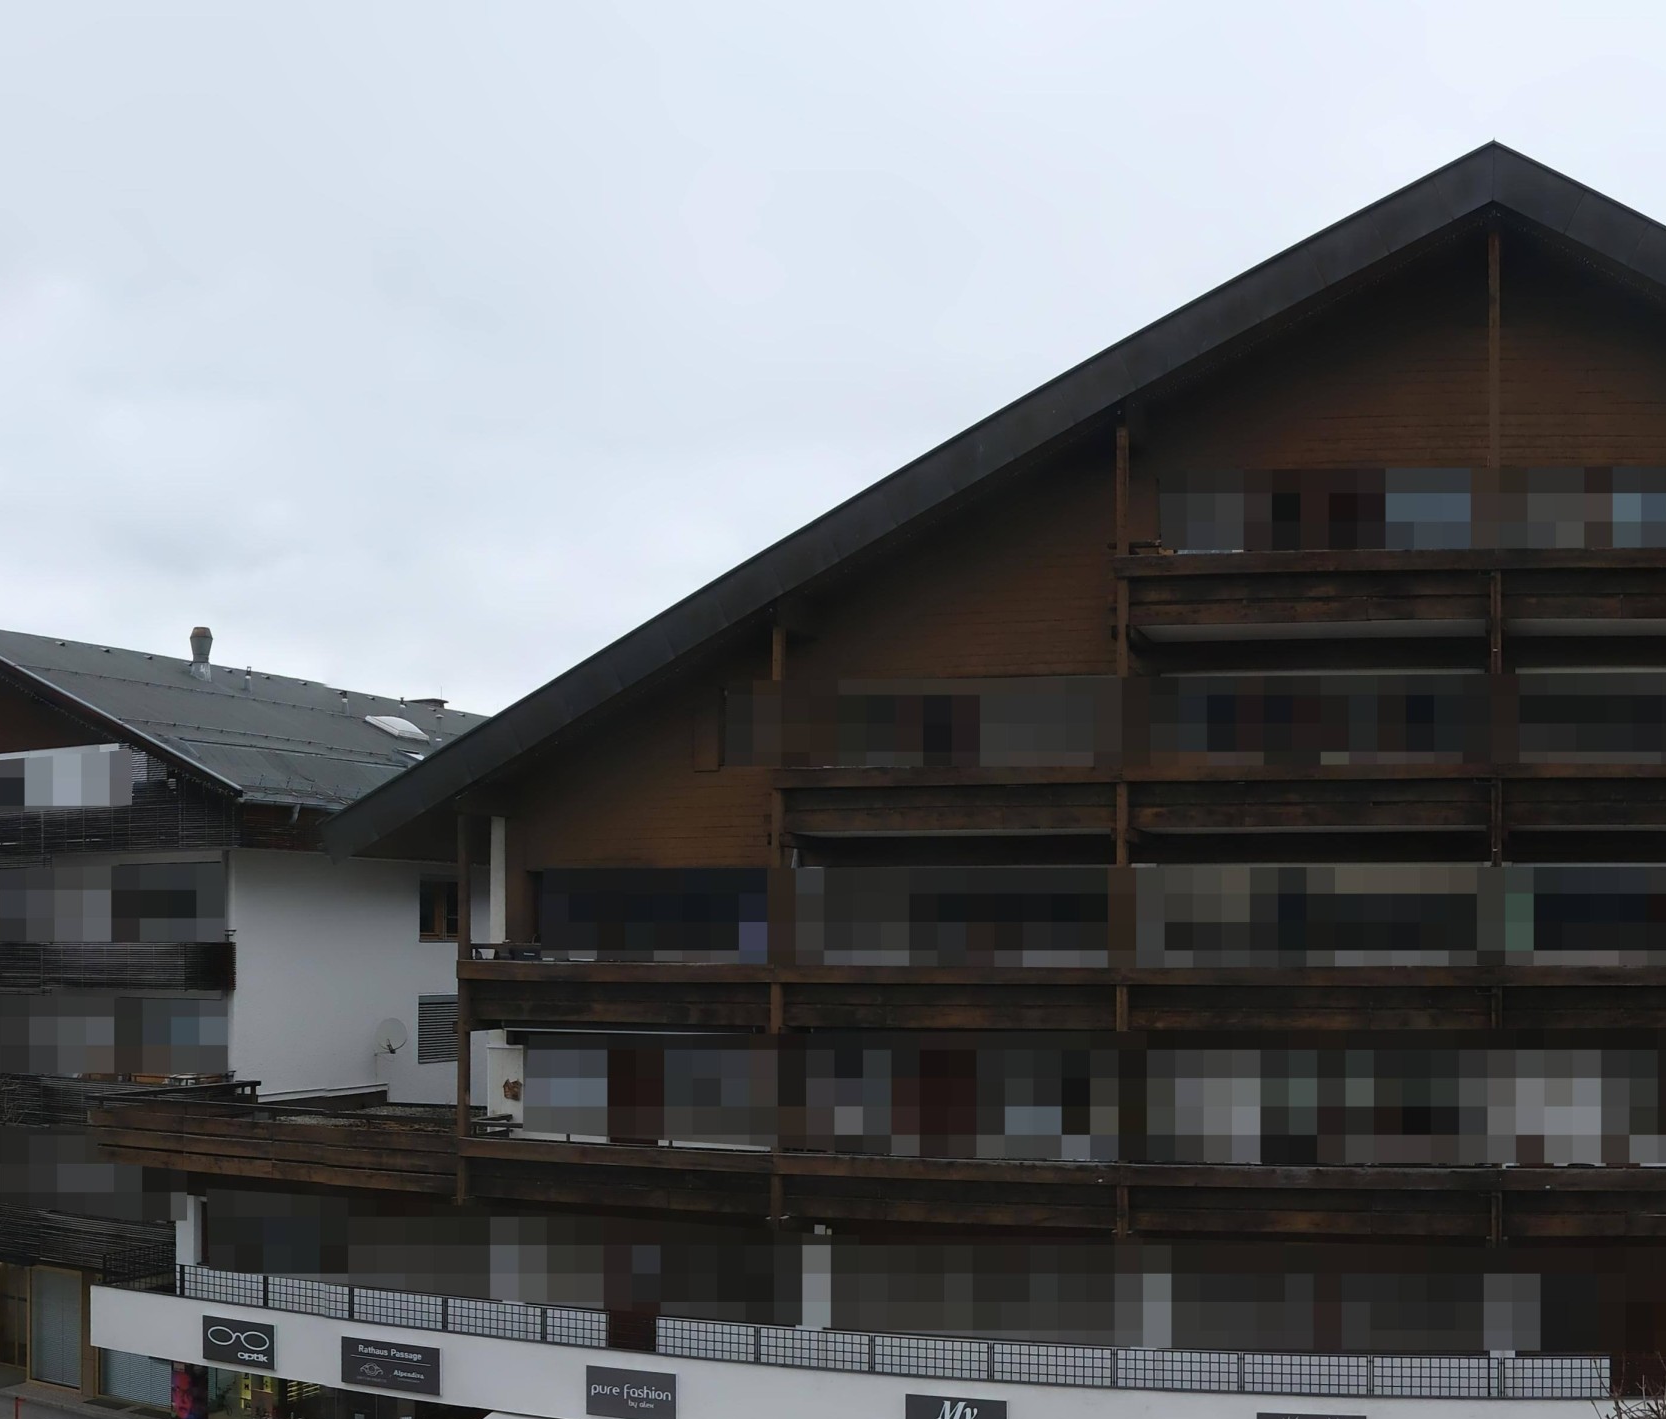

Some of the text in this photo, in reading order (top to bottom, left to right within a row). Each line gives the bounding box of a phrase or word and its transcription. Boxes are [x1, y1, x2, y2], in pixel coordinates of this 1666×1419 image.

[237, 1351, 269, 1363] optik
[358, 1344, 423, 1362] Rathaus Passage
[590, 1383, 672, 1401] pure fashion
[628, 1399, 638, 1409] by
